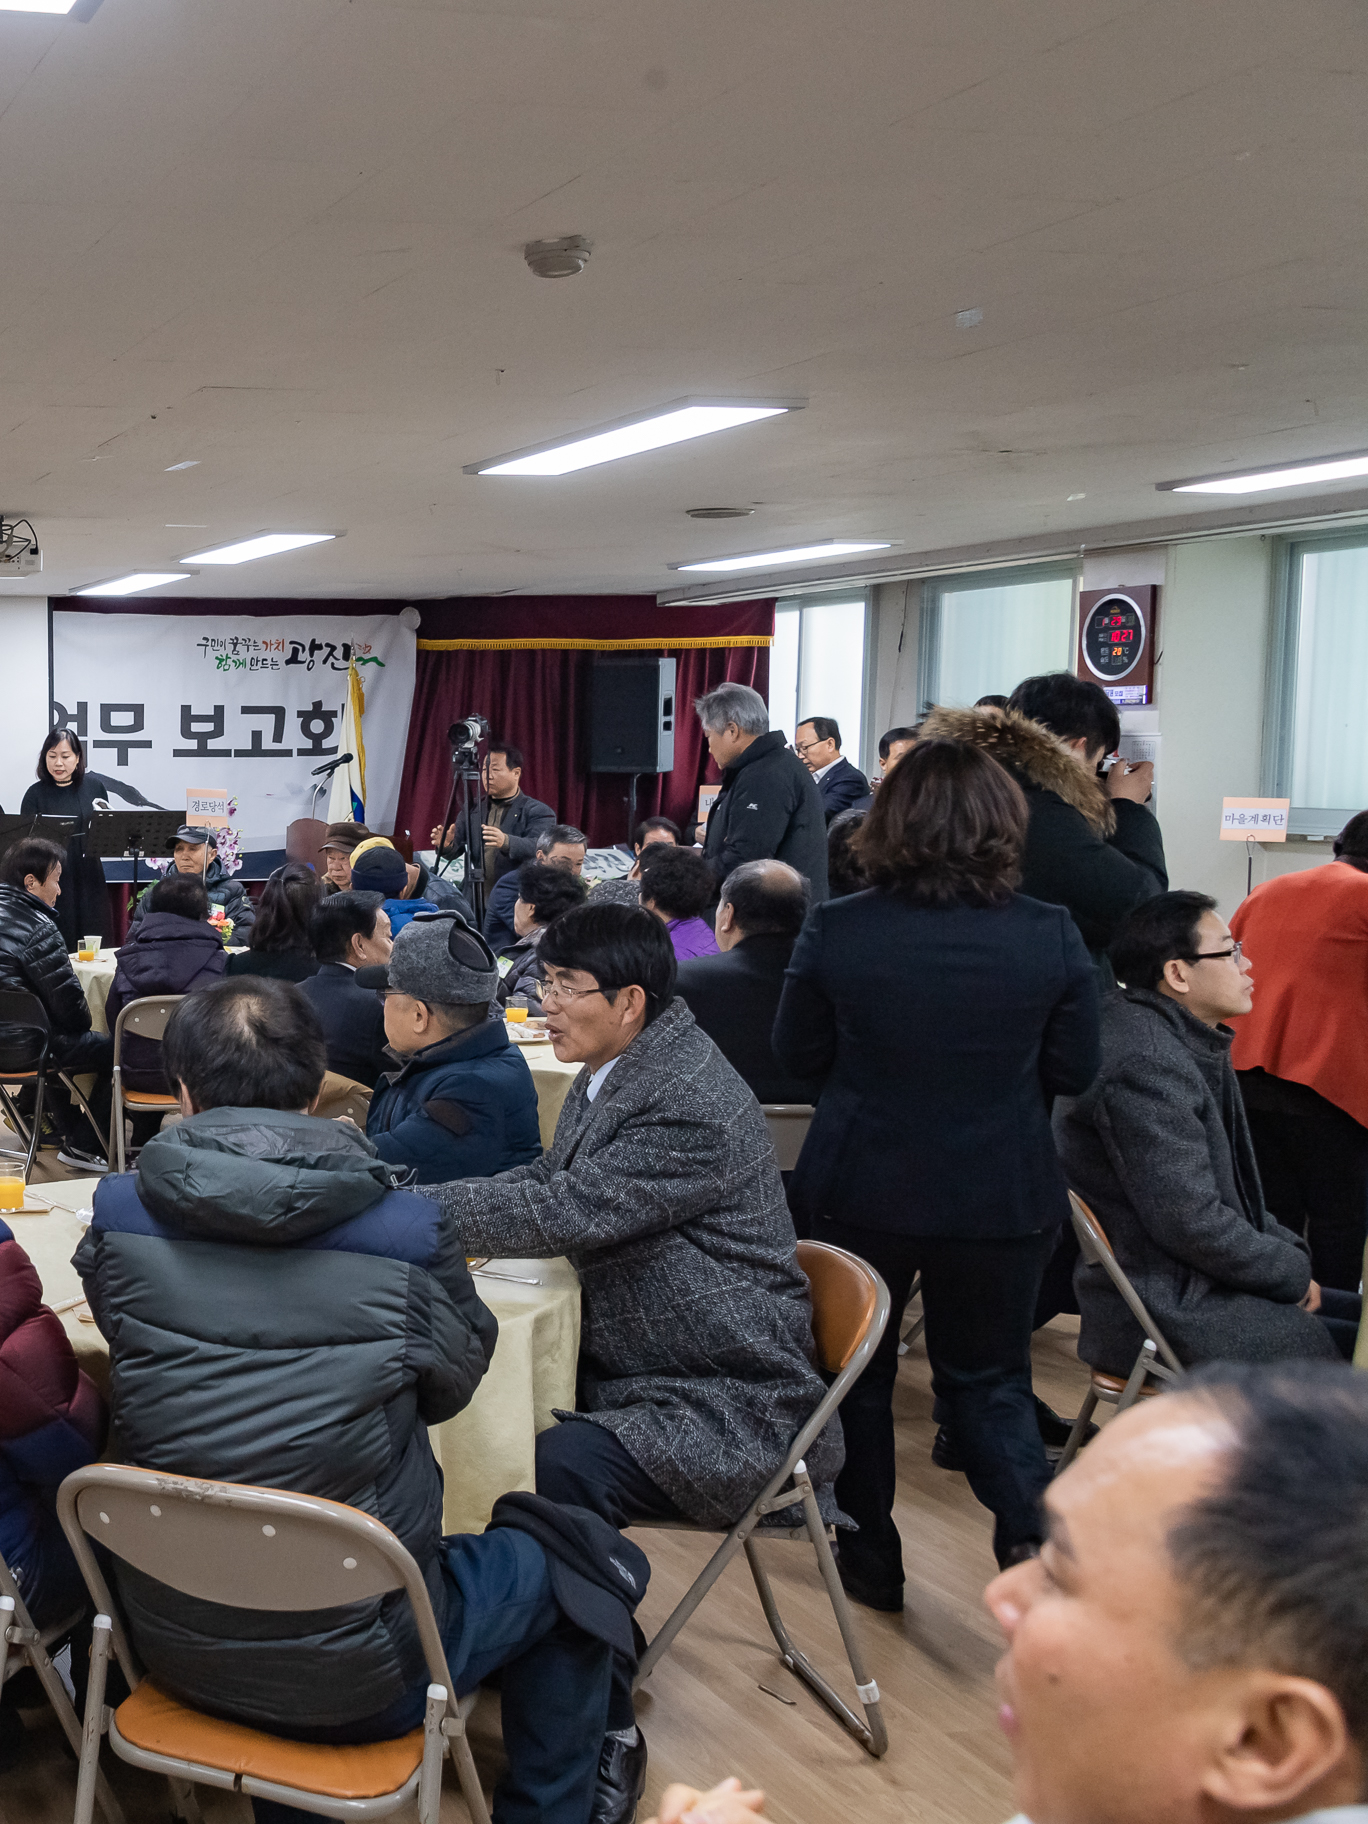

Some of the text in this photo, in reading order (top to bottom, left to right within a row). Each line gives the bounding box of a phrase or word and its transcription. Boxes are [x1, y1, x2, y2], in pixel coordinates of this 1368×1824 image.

[228, 636, 262, 656] 꿈꾸는
[262, 638, 285, 653] 가치
[1112, 647, 1122, 656] 20
[214, 653, 281, 671] 함께 만드는
[285, 638, 352, 671] 광진
[191, 799, 225, 814] 경로당석
[1224, 812, 1285, 826] 마을계획단
